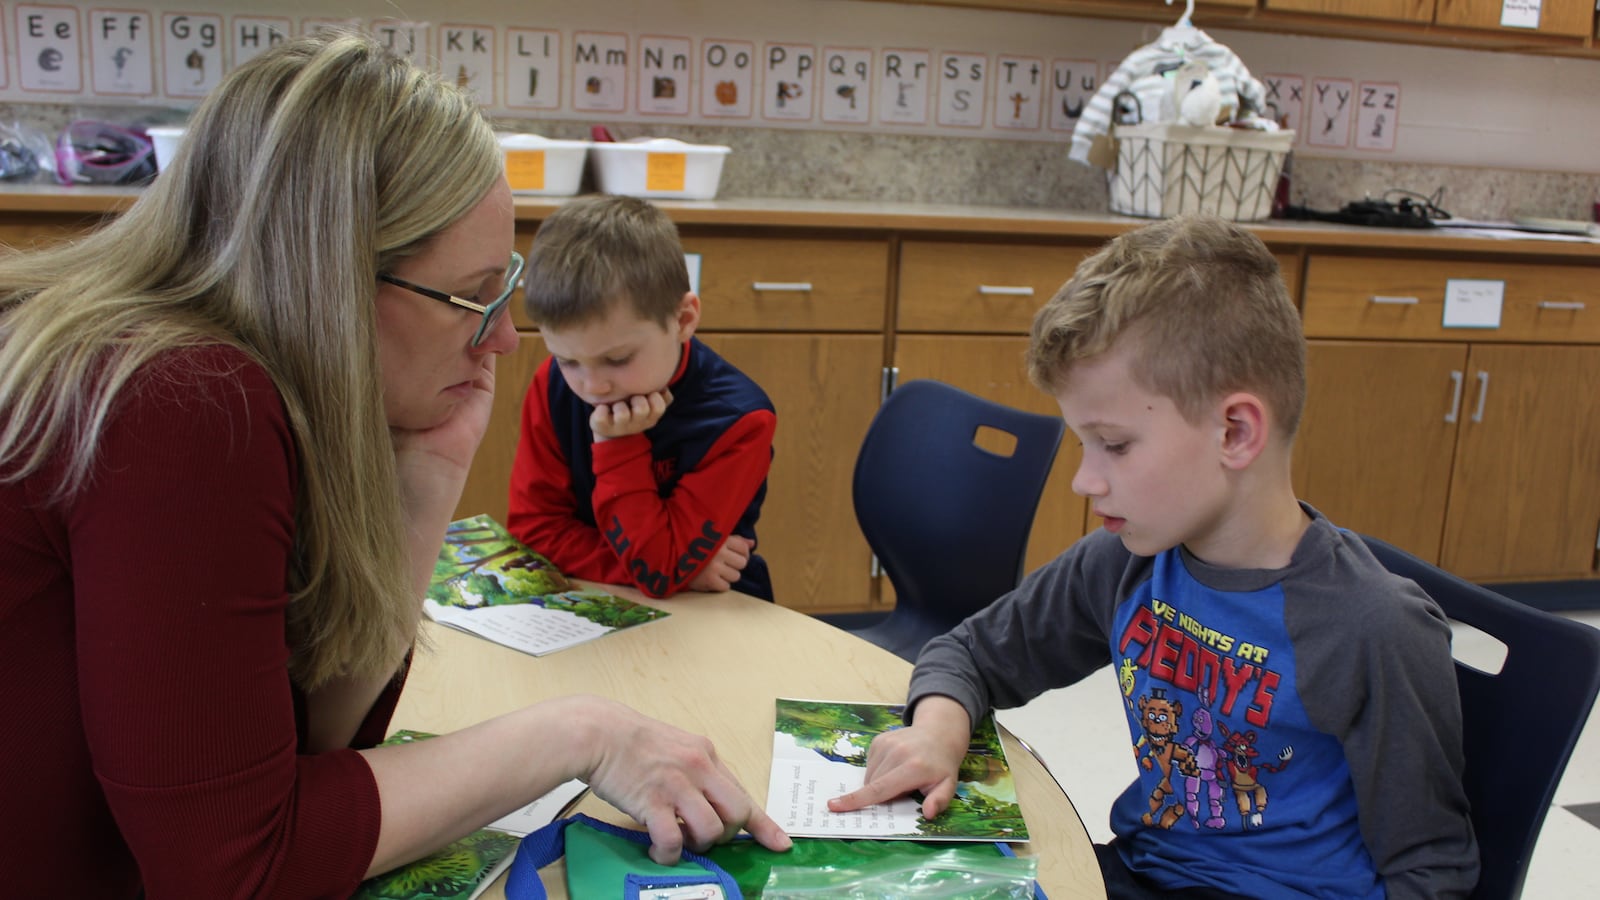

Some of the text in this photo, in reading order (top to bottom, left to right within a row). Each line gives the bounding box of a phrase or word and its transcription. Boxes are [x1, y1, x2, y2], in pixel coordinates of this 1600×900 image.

[1152, 599, 1270, 664] VE NIGHTS AT
